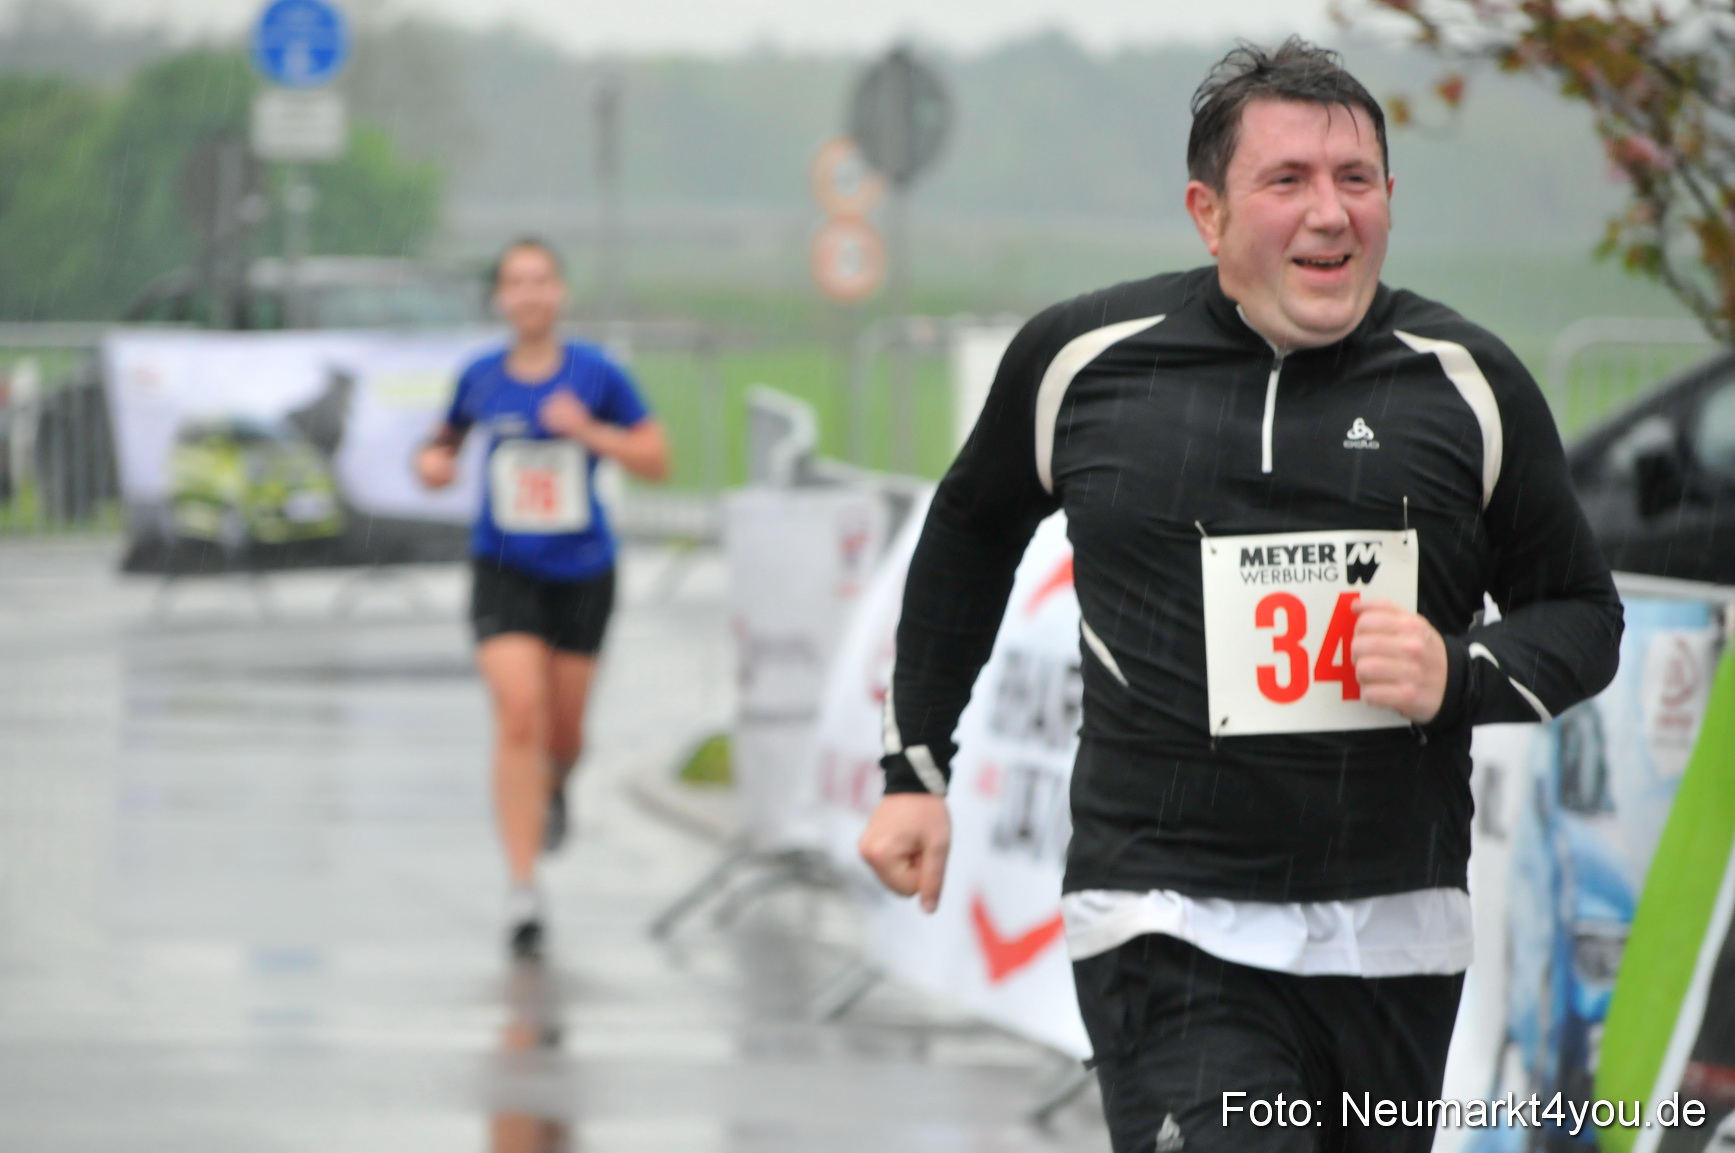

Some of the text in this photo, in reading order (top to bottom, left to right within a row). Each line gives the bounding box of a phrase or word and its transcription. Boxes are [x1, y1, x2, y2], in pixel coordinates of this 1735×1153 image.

[1240, 543, 1337, 567] MEYER
[1240, 566, 1339, 585] WERBUNG
[1255, 591, 1361, 705] 34
